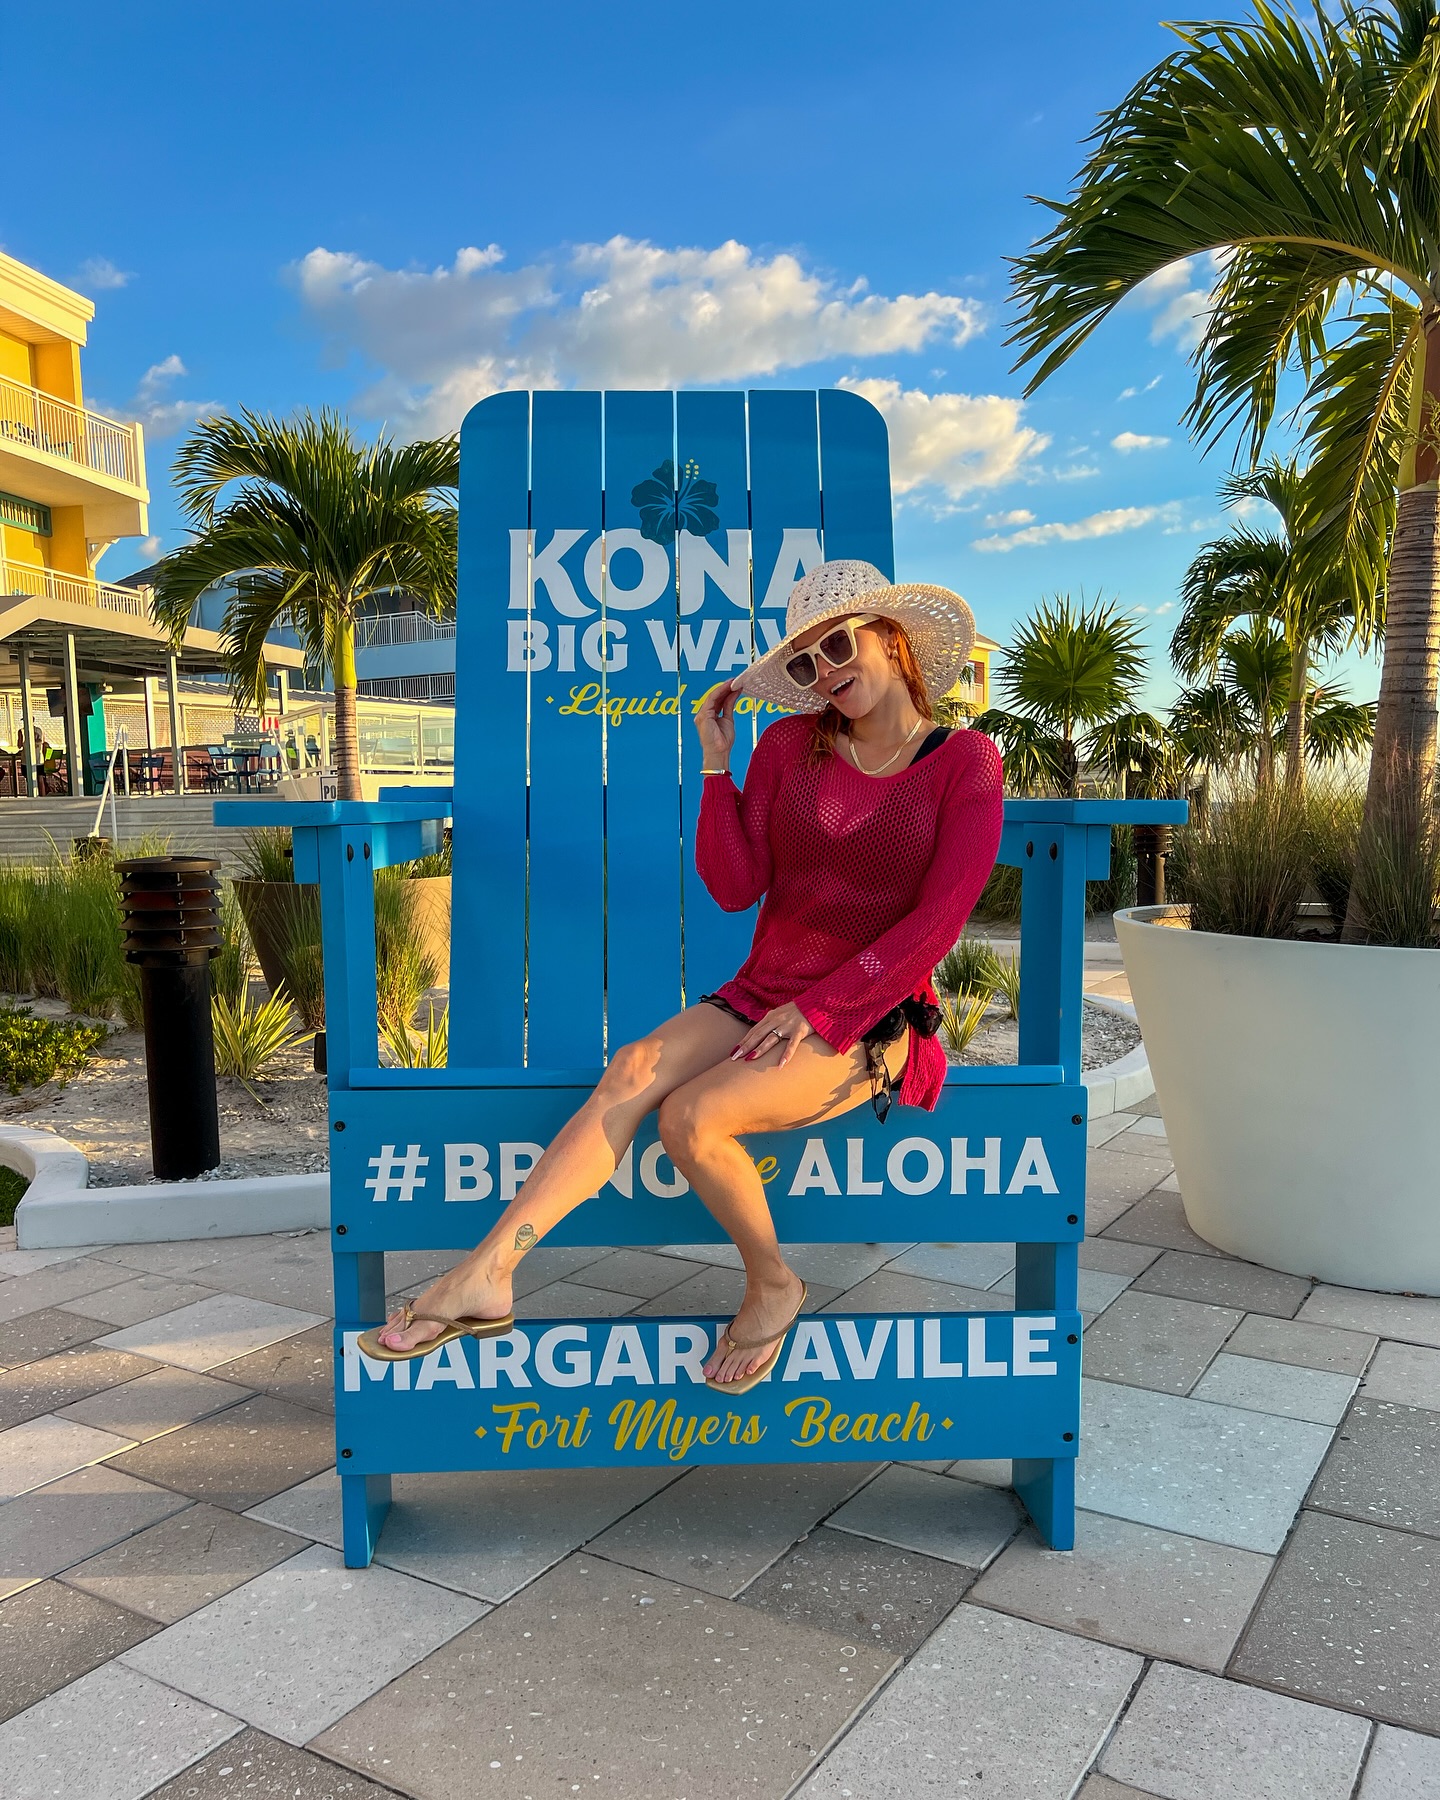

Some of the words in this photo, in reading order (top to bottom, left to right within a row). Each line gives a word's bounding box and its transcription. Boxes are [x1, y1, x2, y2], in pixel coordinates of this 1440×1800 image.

[506, 619, 629, 673] BIG
[559, 682, 688, 727] Liquid
[323, 785, 337, 799] PO
[787, 1137, 1061, 1196] ALOHA
[343, 1317, 1058, 1392] MARGARAVILLE
[492, 1402, 593, 1454] Fort
[608, 1398, 768, 1461] Myers
[784, 1396, 936, 1448] Beach
